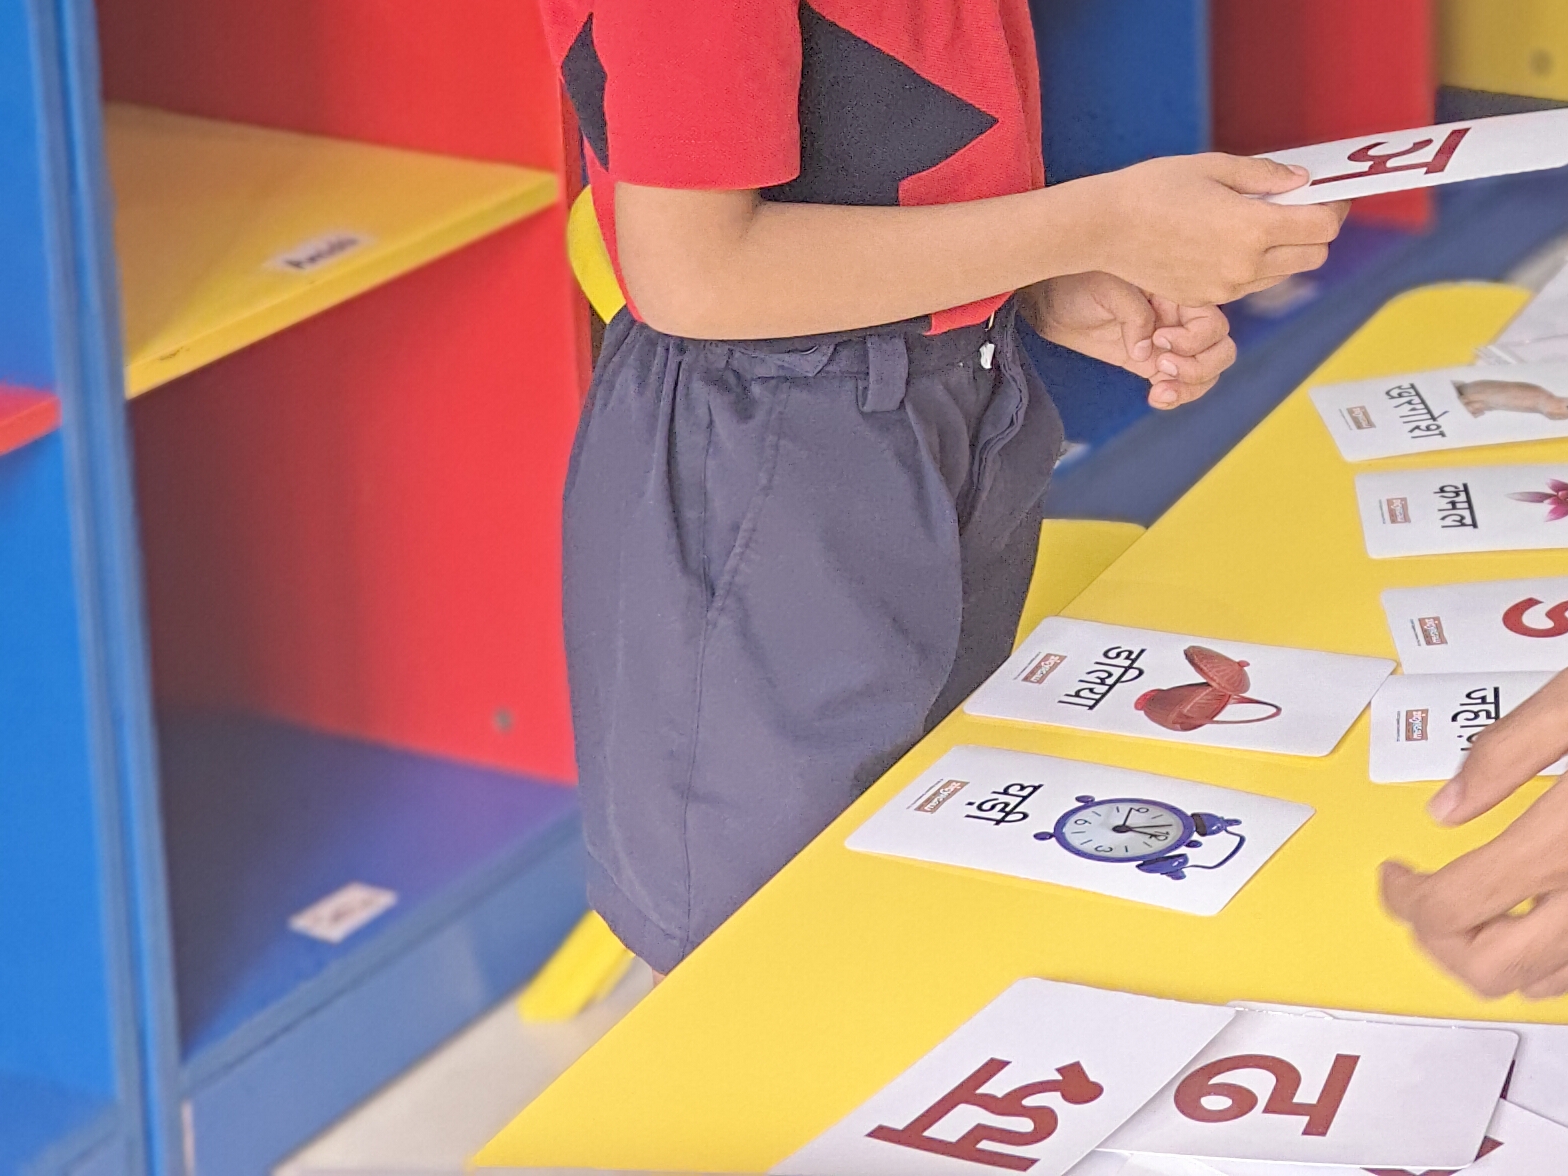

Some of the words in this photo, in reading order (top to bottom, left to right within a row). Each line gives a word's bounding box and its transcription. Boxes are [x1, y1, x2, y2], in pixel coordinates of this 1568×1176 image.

[1385, 383, 1449, 438] खरगोश
[1433, 482, 1479, 529] कमल
[1057, 645, 1147, 712] डलिया
[964, 781, 1045, 826] घड़ी
[867, 1058, 1104, 1172] झ
[1174, 1053, 1360, 1137] ढ
